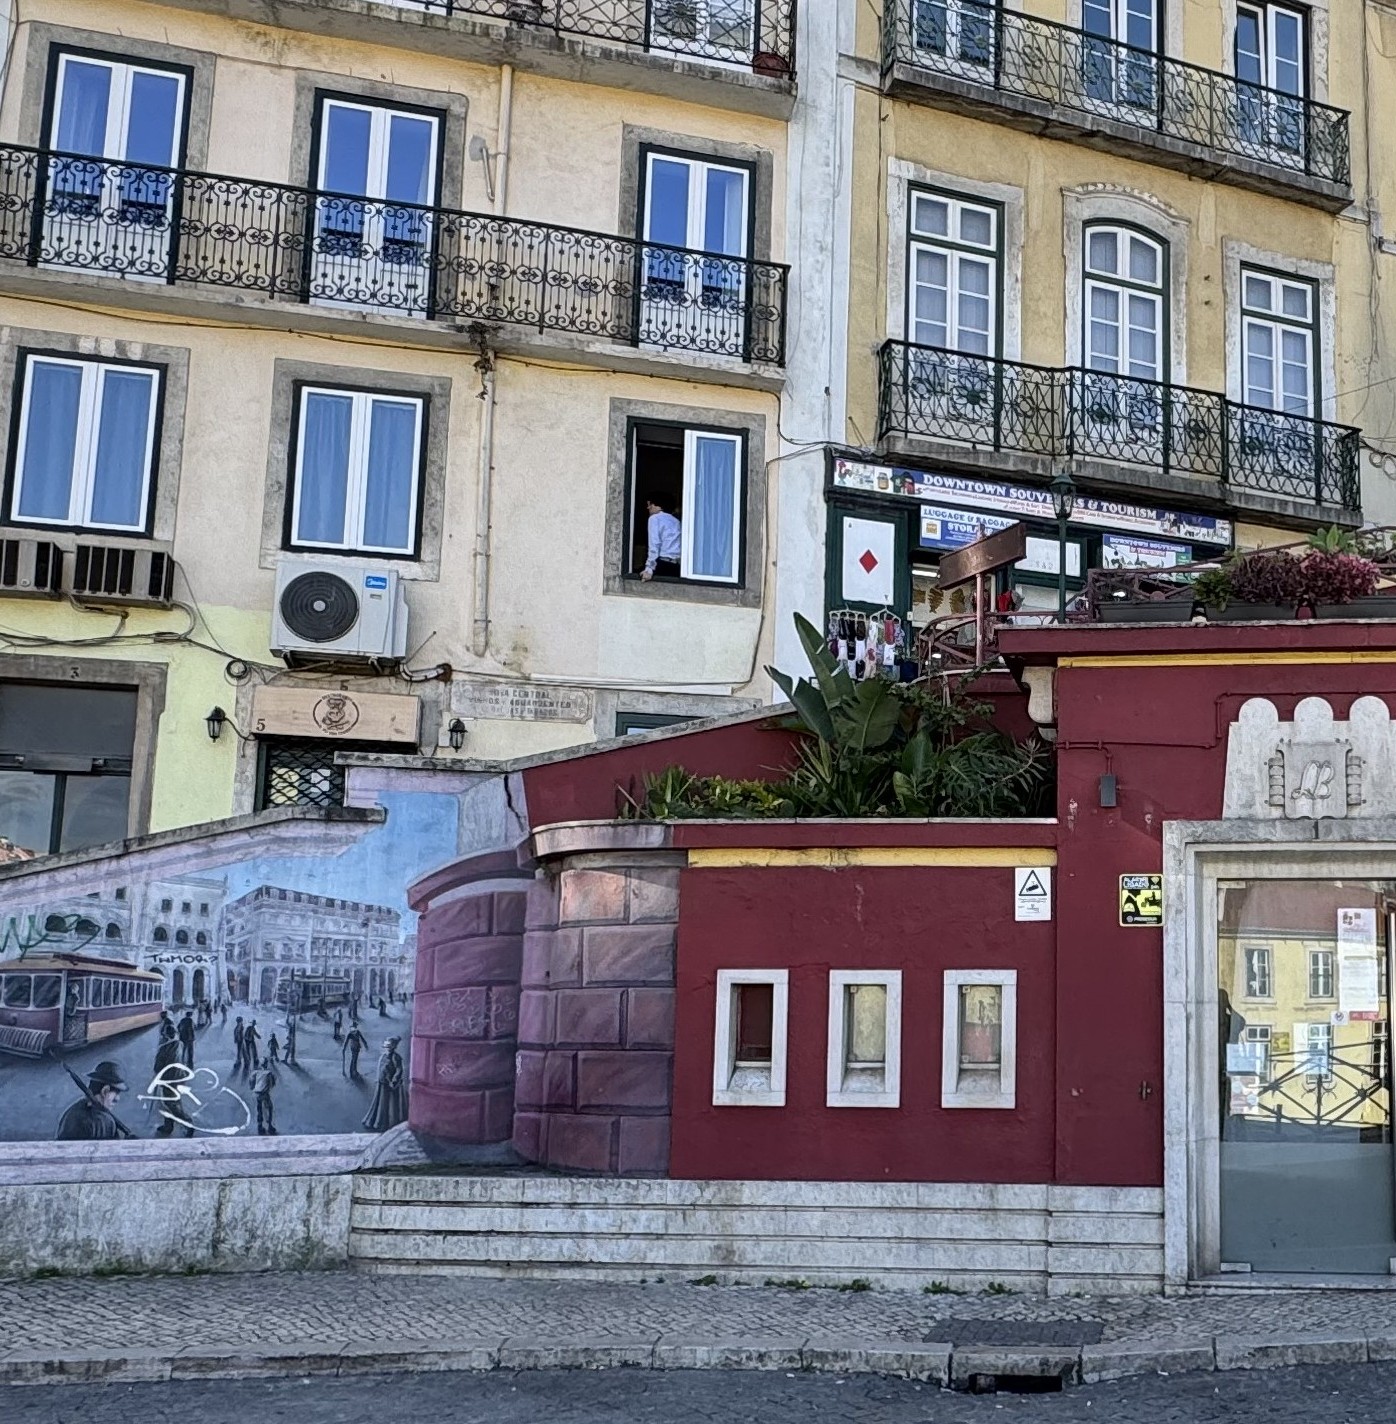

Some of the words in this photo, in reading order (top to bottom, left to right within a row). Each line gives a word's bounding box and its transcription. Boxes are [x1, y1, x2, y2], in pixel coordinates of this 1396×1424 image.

[923, 474, 1006, 497] DOWNTOWN
[1009, 484, 1085, 508] SOUVES
[1087, 498, 1099, 510] &
[1100, 501, 1157, 520] TOURISM
[923, 508, 965, 521] LUGGAGE
[70, 666, 80, 680] 3
[512, 690, 550, 700] CENTRAL
[256, 718, 266, 732] 5
